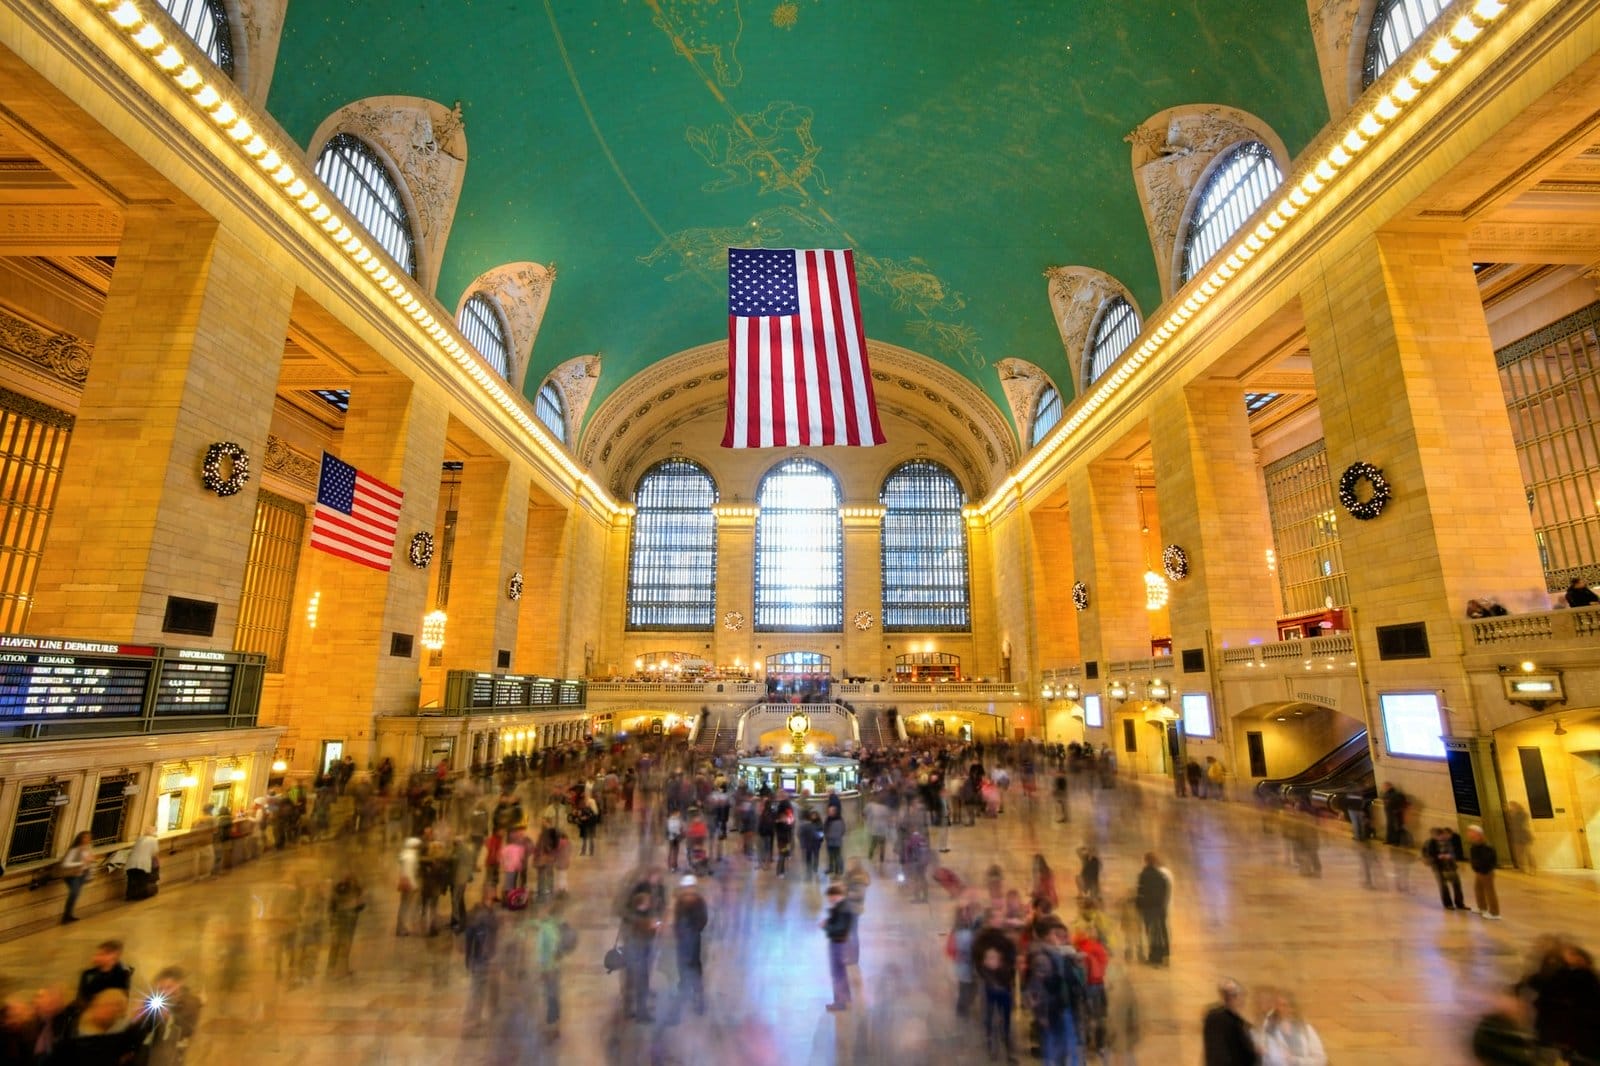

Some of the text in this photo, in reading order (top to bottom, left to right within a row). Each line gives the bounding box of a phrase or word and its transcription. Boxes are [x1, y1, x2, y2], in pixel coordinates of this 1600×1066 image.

[1, 638, 119, 653] HAVEN LINE DEPARTURES
[38, 656, 75, 664] REMARKS
[179, 650, 225, 660] INFORMATION
